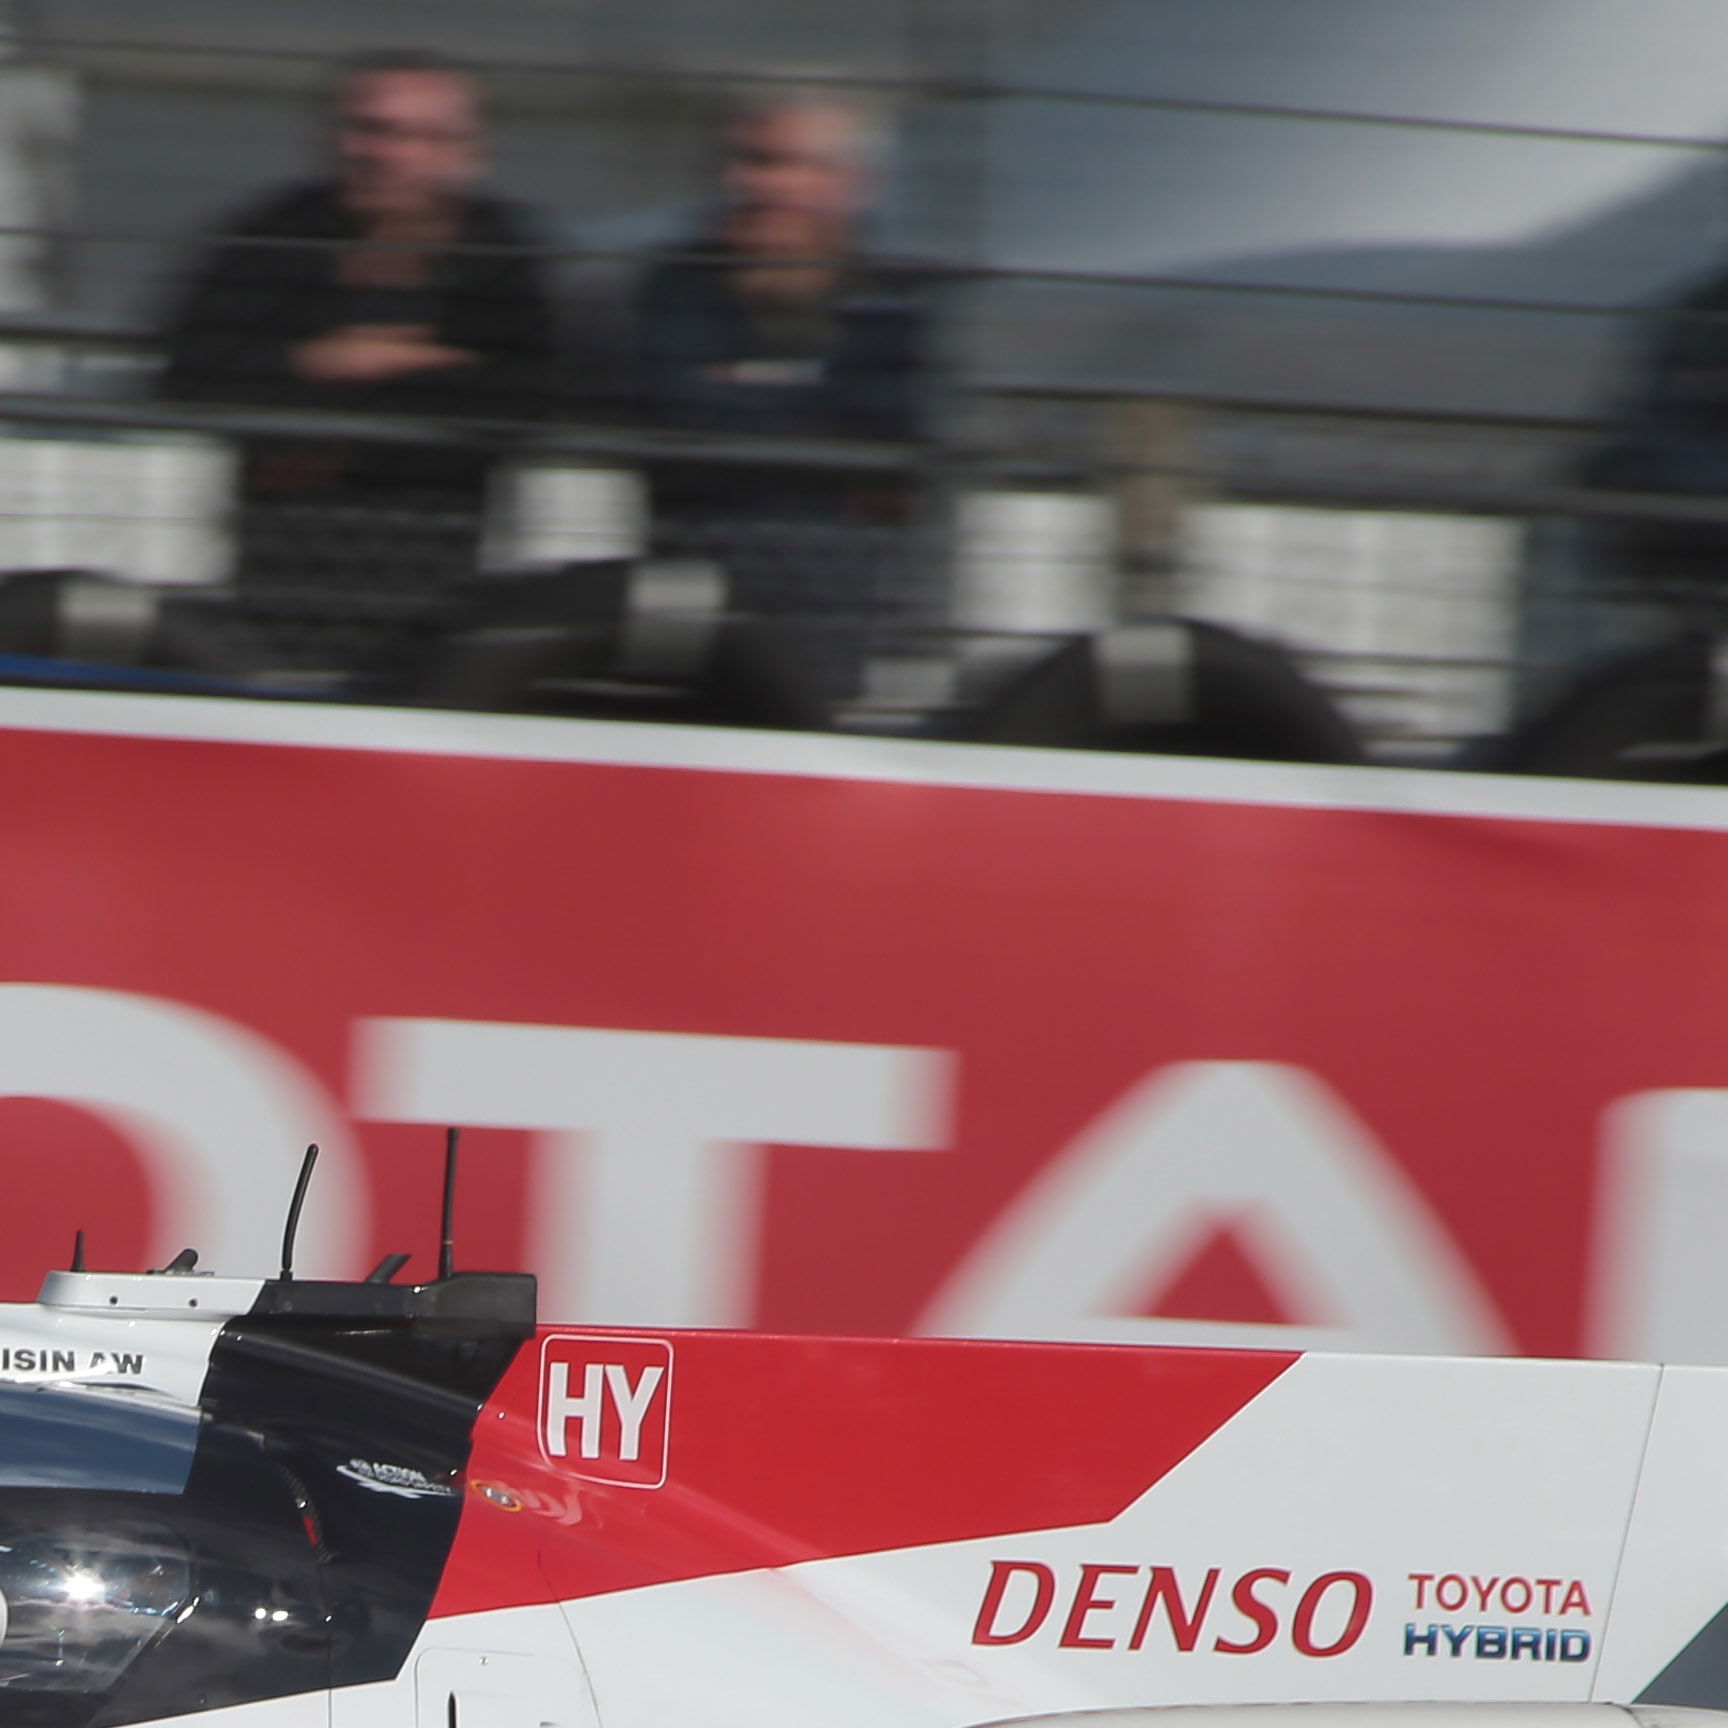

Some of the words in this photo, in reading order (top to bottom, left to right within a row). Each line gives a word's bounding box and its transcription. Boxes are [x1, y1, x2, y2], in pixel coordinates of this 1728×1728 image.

[549, 1362, 665, 1461] HY
[971, 1559, 1374, 1659] DENSO
[1408, 1573, 1592, 1617] TOYOTA
[1403, 1624, 1592, 1664] HYBRID
